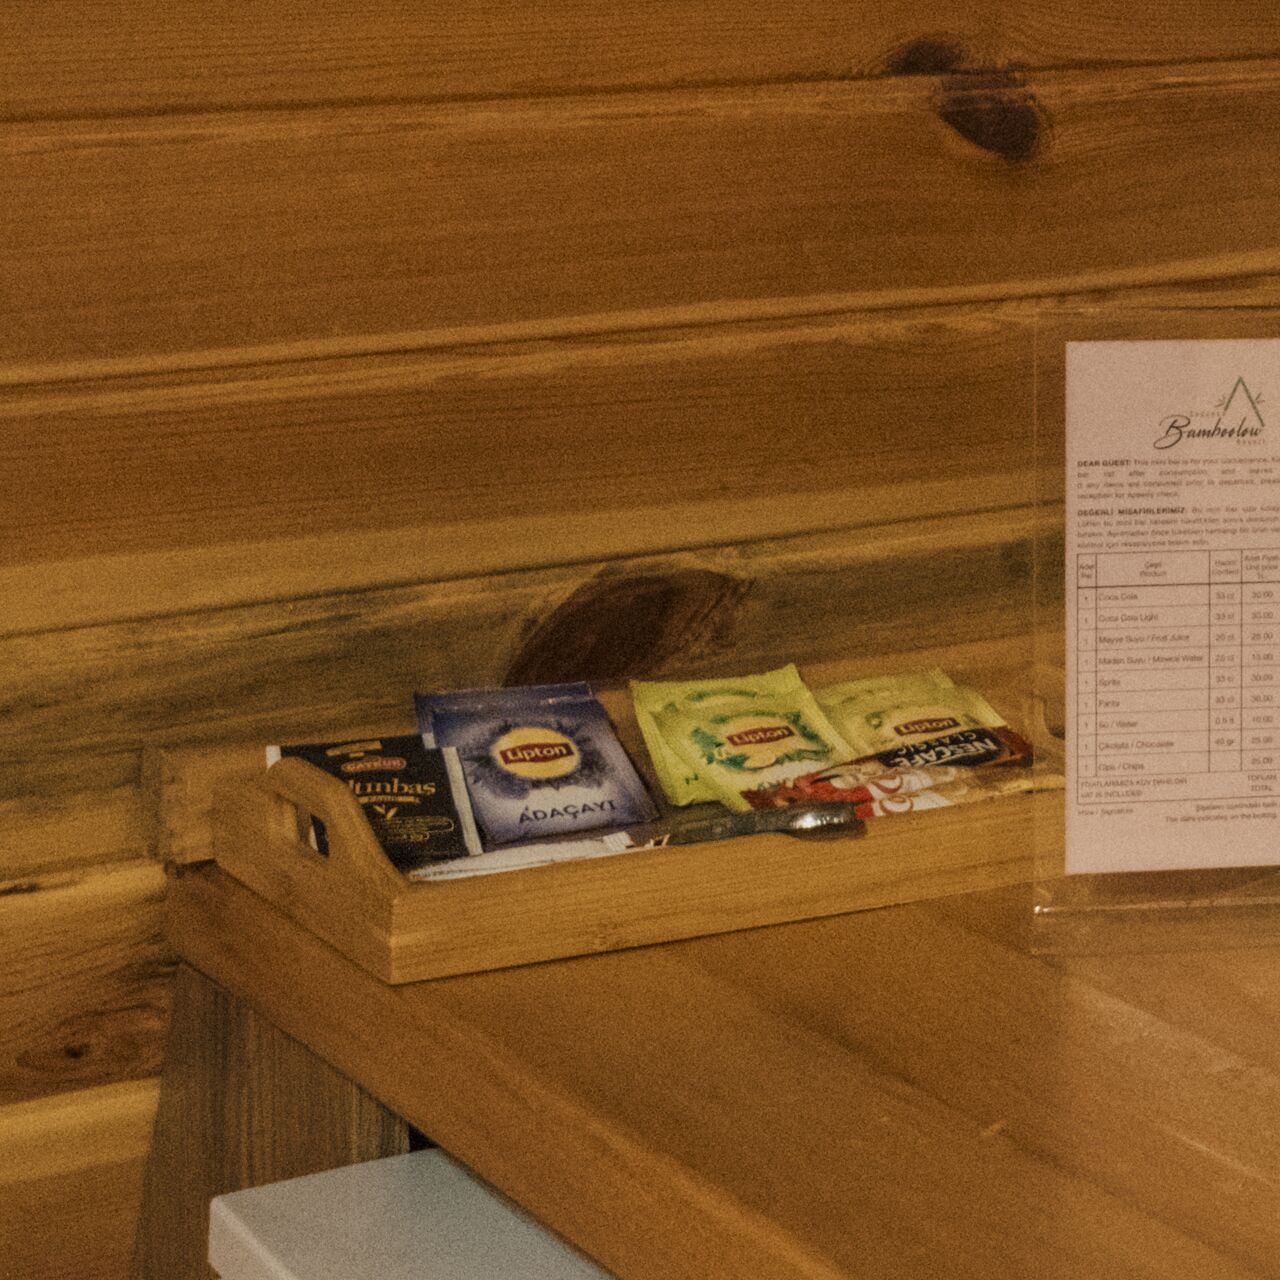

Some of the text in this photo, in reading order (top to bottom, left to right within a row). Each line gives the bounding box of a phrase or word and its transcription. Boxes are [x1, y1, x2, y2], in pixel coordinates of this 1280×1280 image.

[1153, 414, 1263, 449] Bamboolow
[733, 728, 789, 743] Lipton
[506, 745, 568, 760] Lipton
[519, 800, 617, 823] ADAÇAYI
